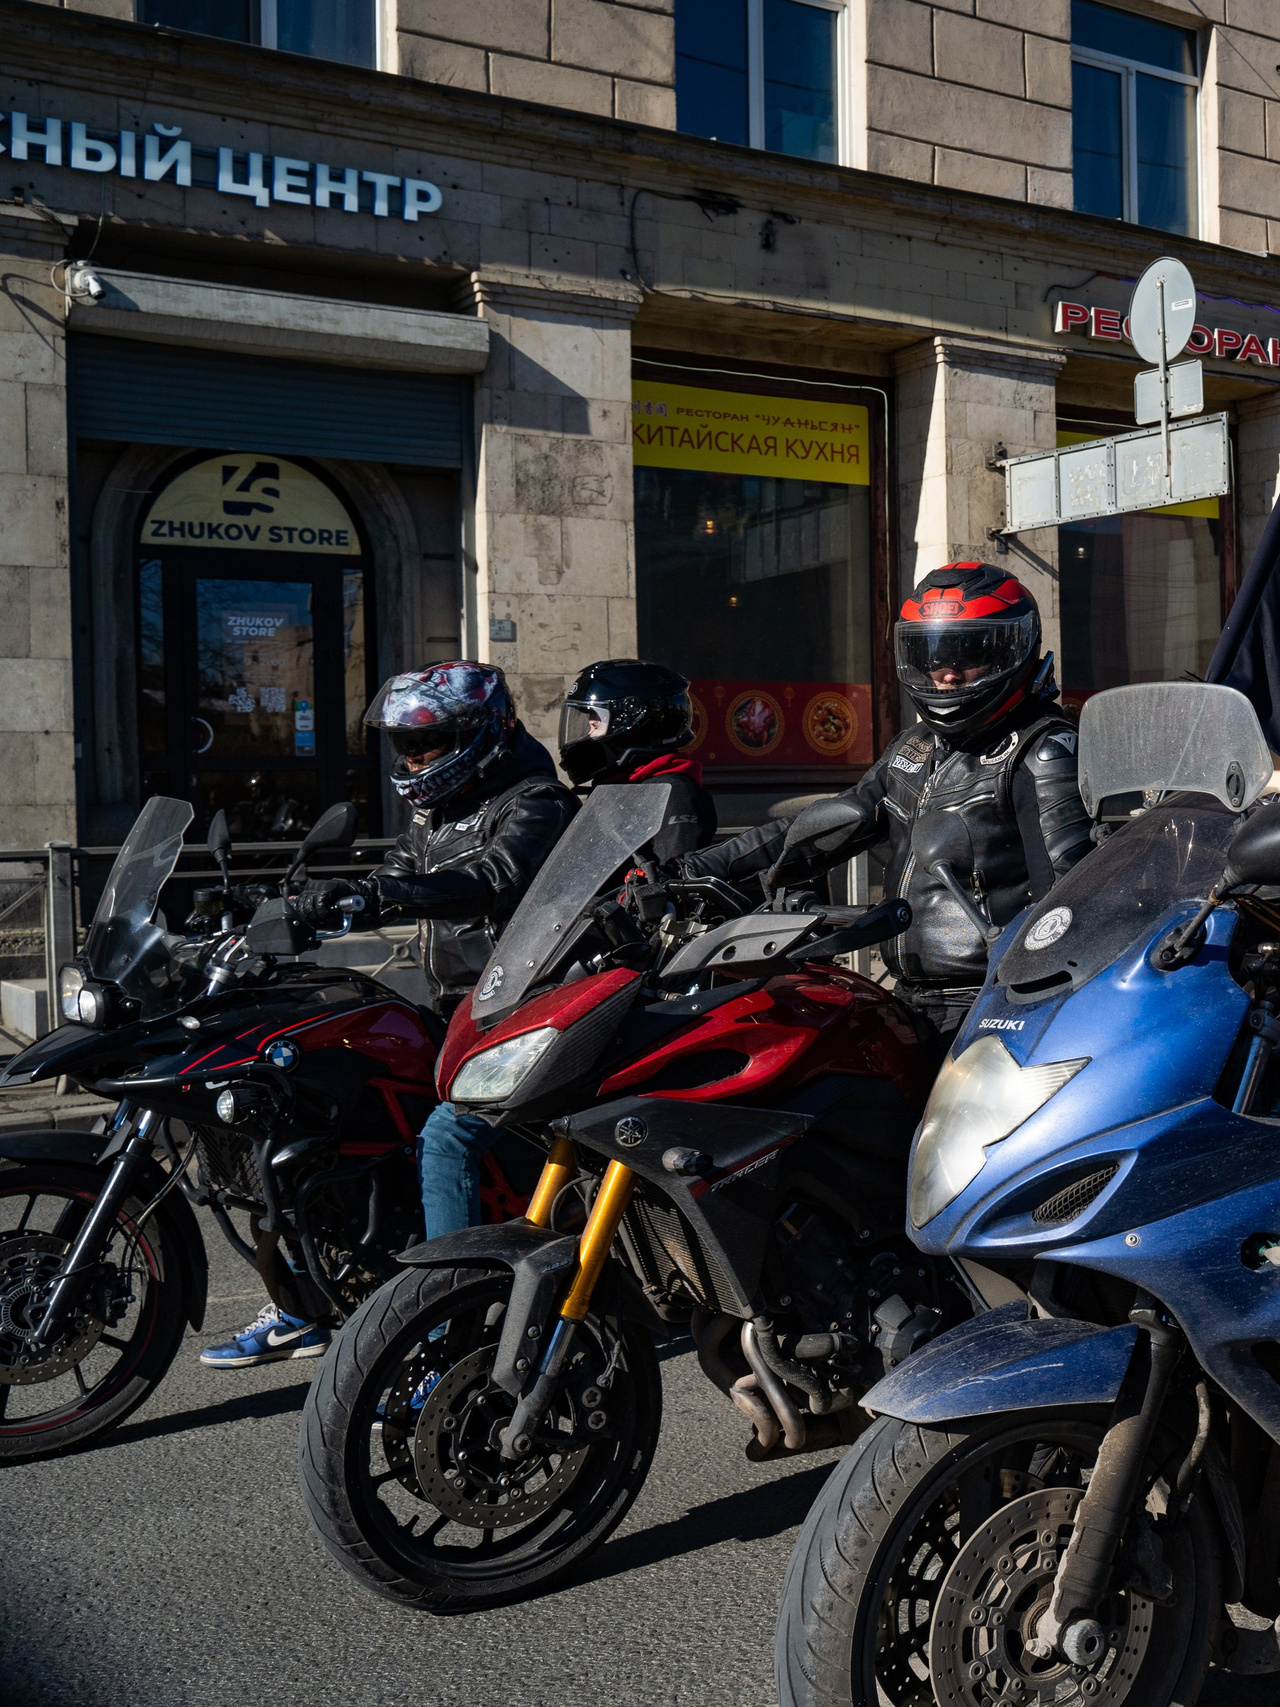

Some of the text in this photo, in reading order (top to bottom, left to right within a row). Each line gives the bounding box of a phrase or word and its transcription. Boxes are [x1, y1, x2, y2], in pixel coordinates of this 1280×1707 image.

[0, 110, 444, 222] НЫЙ ЦЕНТР
[676, 406, 750, 423] РЕСТОРАН
[631, 423, 861, 465] КИТАЙСКАЯ КУХНЯ
[150, 519, 350, 547] ZHUKOV STORE
[923, 602, 959, 615] SHOEI
[227, 616, 284, 627] ZHUKOV
[232, 626, 276, 637] STORE
[668, 814, 699, 825] LS2
[979, 1018, 1026, 1031] SUZUKI
